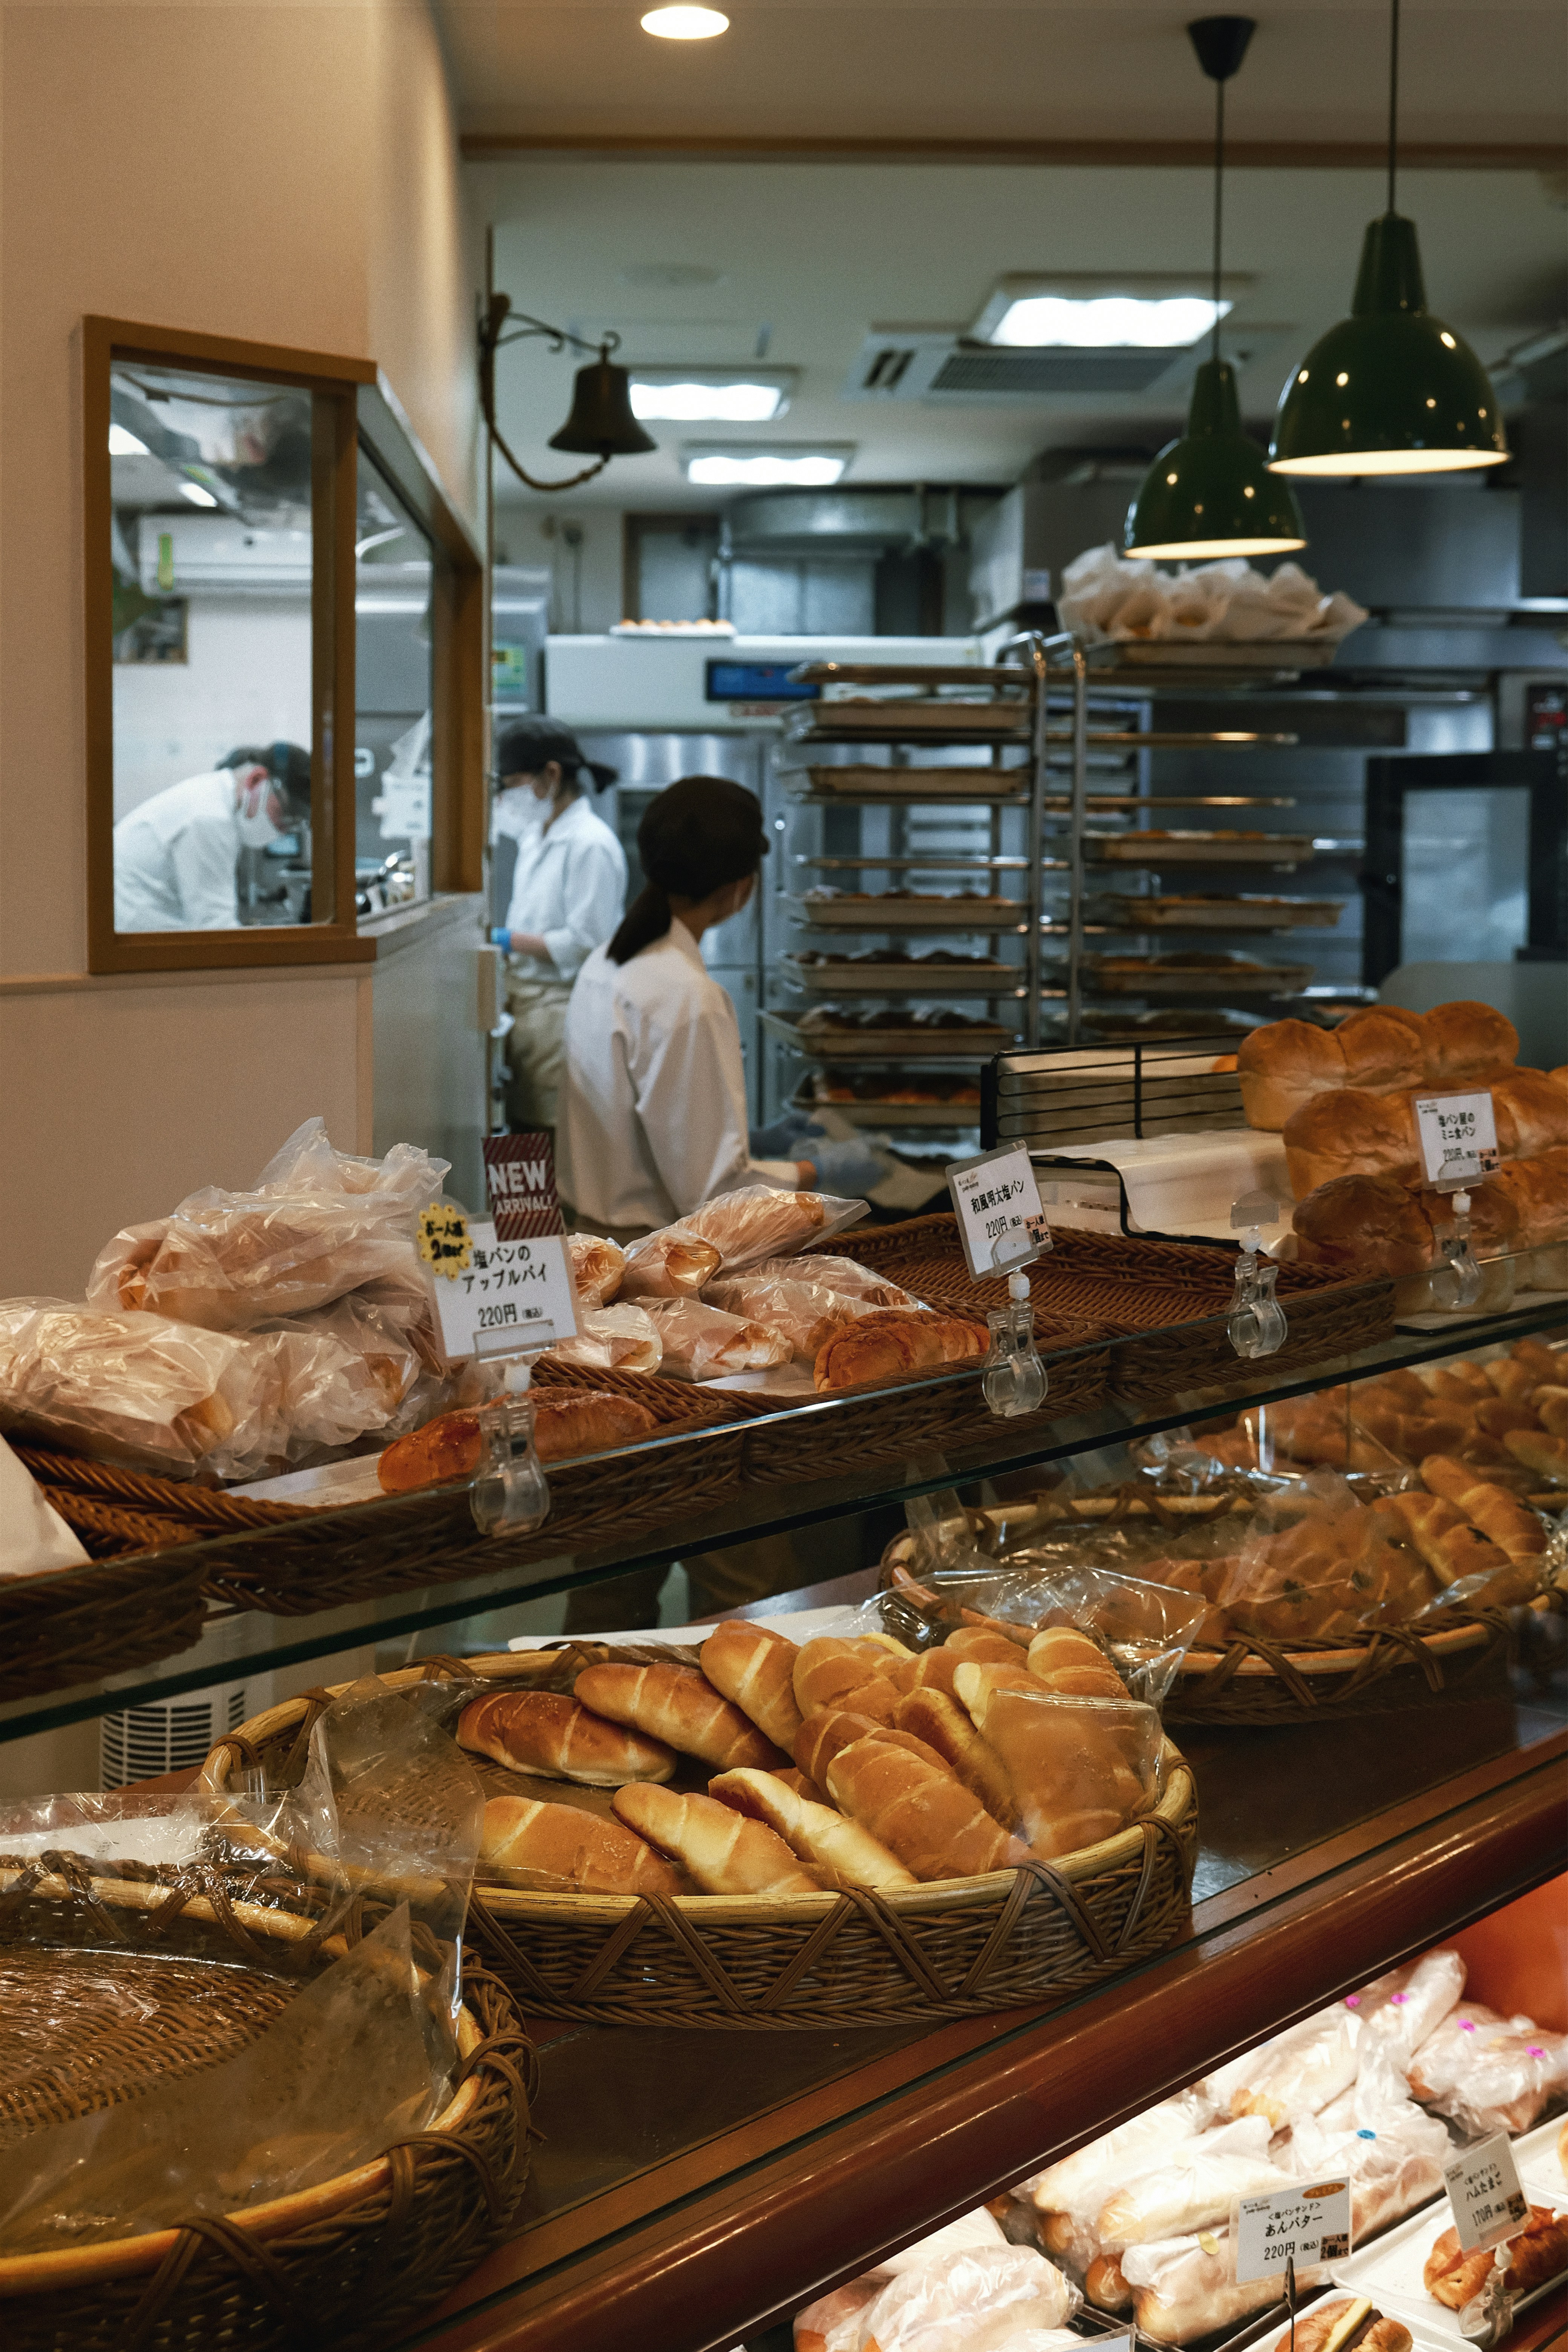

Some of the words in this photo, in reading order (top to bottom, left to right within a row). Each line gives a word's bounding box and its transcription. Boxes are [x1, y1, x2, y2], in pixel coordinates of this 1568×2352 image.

[488, 1159, 547, 1194] NEW
[496, 1194, 553, 1216] ARRIVAL!
[971, 1180, 1024, 1214] 和風明太塩パン
[986, 1216, 1008, 1239] 220円
[473, 1245, 530, 1269] 塩パンの
[462, 1262, 548, 1294] アップルパイ
[478, 1303, 517, 1327] 220円
[1265, 2215, 1323, 2237] あんバター
[1264, 2241, 1295, 2260] 220円
[1300, 2239, 1319, 2252] (税込)
